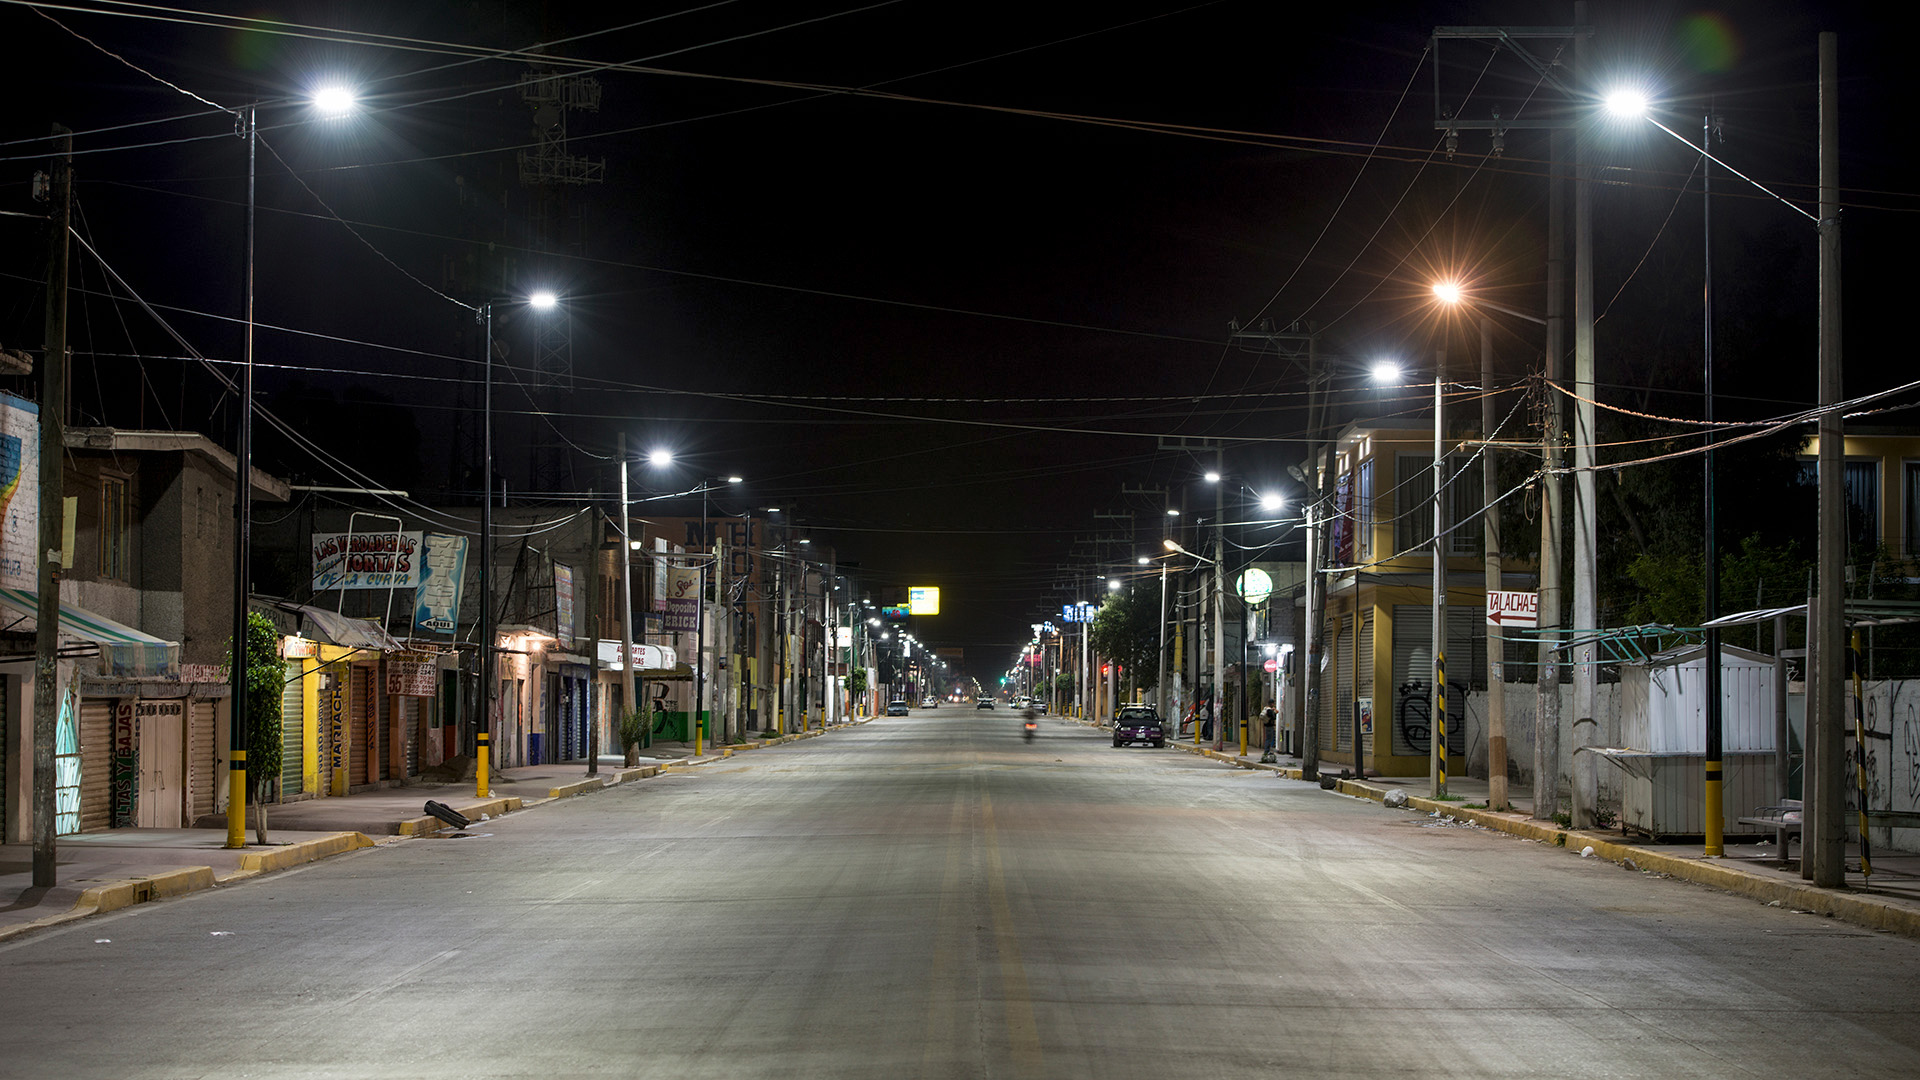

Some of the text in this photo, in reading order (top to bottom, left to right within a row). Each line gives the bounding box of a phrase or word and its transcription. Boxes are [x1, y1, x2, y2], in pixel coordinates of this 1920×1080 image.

[314, 533, 417, 561] LAS VERDADERAS
[340, 552, 411, 573] TORTAS
[320, 572, 338, 586] DE
[366, 573, 409, 586] CURVA
[1488, 593, 1537, 612] TALACHAS
[665, 615, 696, 629] ERICK
[389, 674, 403, 693] 55
[118, 704, 132, 758] BAJAS
[333, 680, 343, 768] MARIACHI
